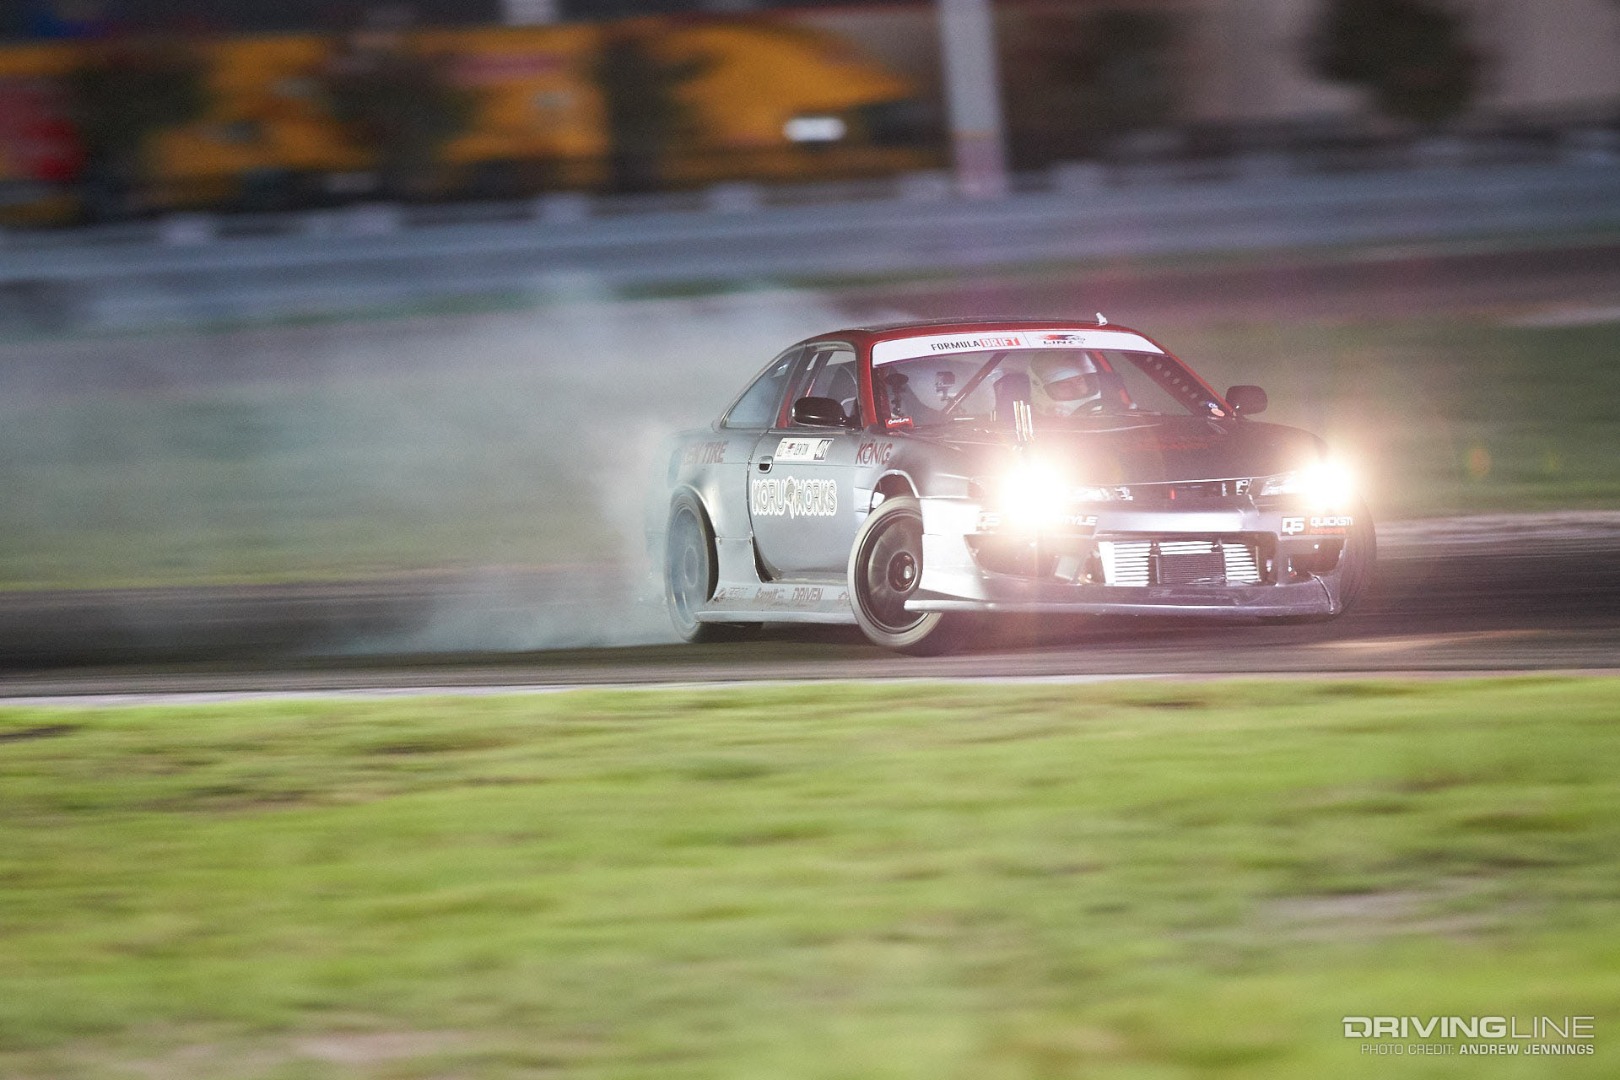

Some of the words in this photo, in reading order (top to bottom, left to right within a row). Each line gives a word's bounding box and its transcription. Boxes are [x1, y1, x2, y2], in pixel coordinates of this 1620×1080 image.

[930, 340, 980, 351] FORMULA
[979, 337, 1021, 348] DRIFT
[701, 440, 729, 464] TIRE
[855, 438, 893, 465] KÖNIG
[751, 478, 787, 517] KORU
[793, 478, 838, 517] WORKS
[1281, 517, 1305, 535] QS
[791, 587, 824, 601] DRIVEN
